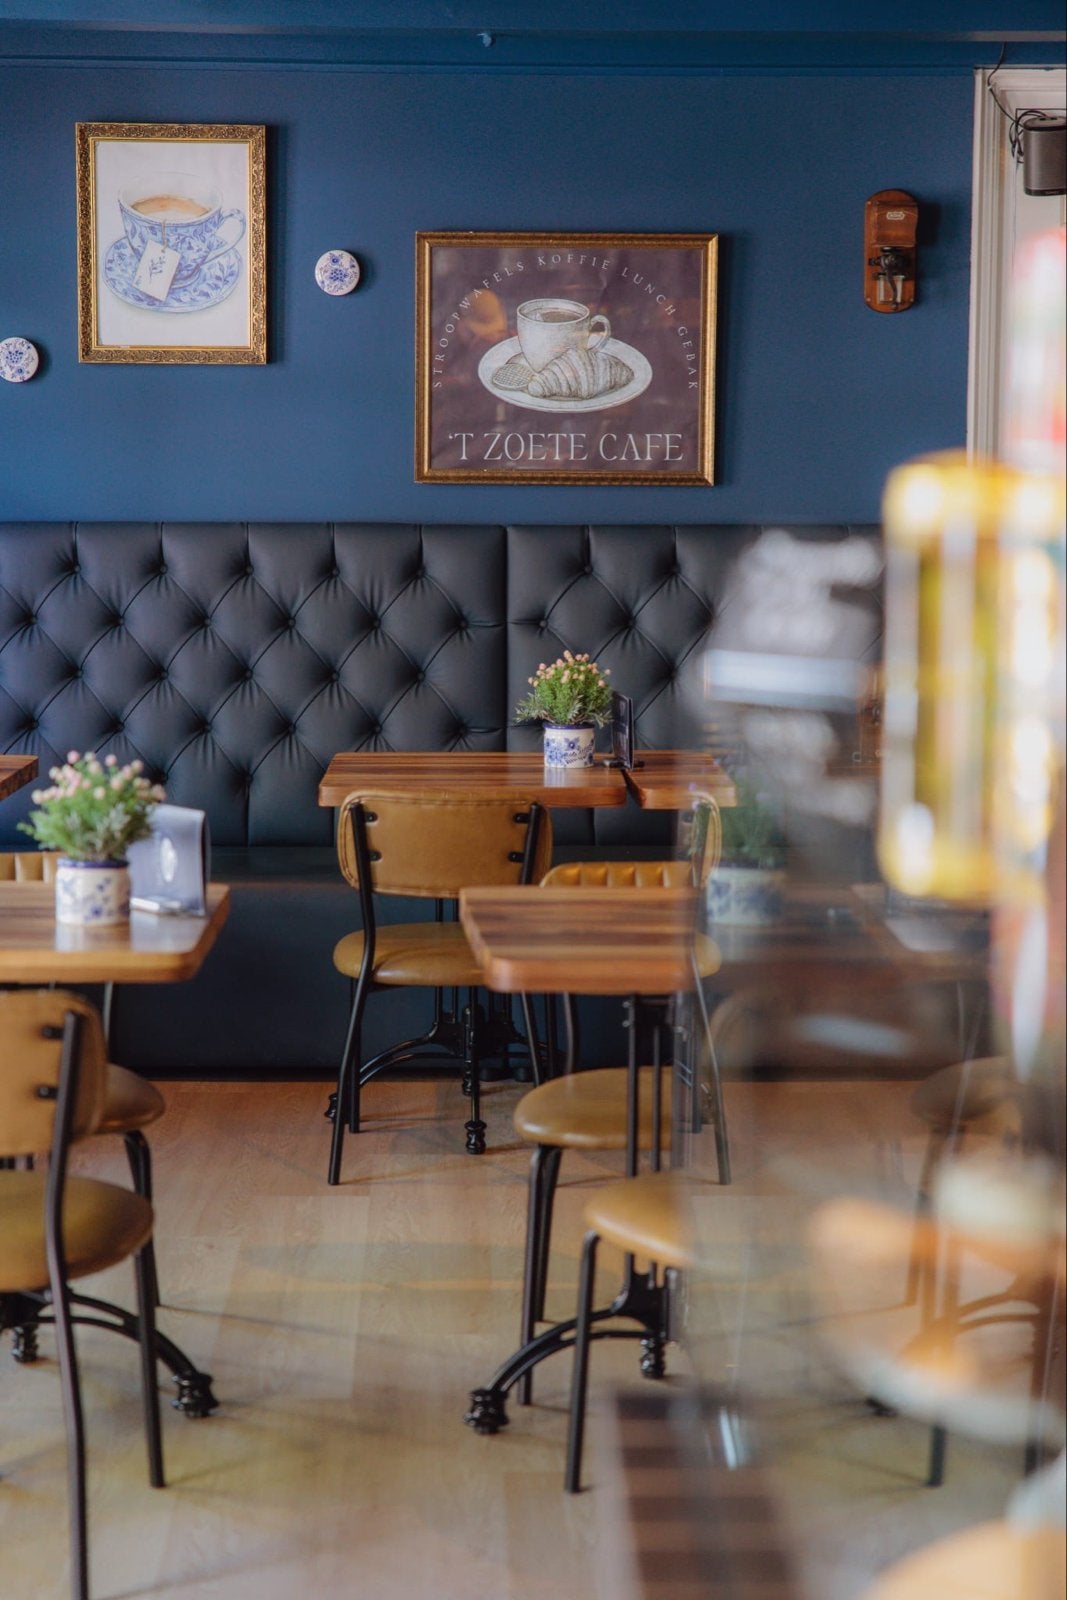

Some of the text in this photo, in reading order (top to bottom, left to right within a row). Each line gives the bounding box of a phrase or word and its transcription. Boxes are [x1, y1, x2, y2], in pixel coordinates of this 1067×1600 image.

[433, 254, 698, 389] STROOPWAFELS KOFFIE LUNCH GEBAK
[483, 433, 589, 461] ZOETE
[599, 433, 684, 461] CAFE
